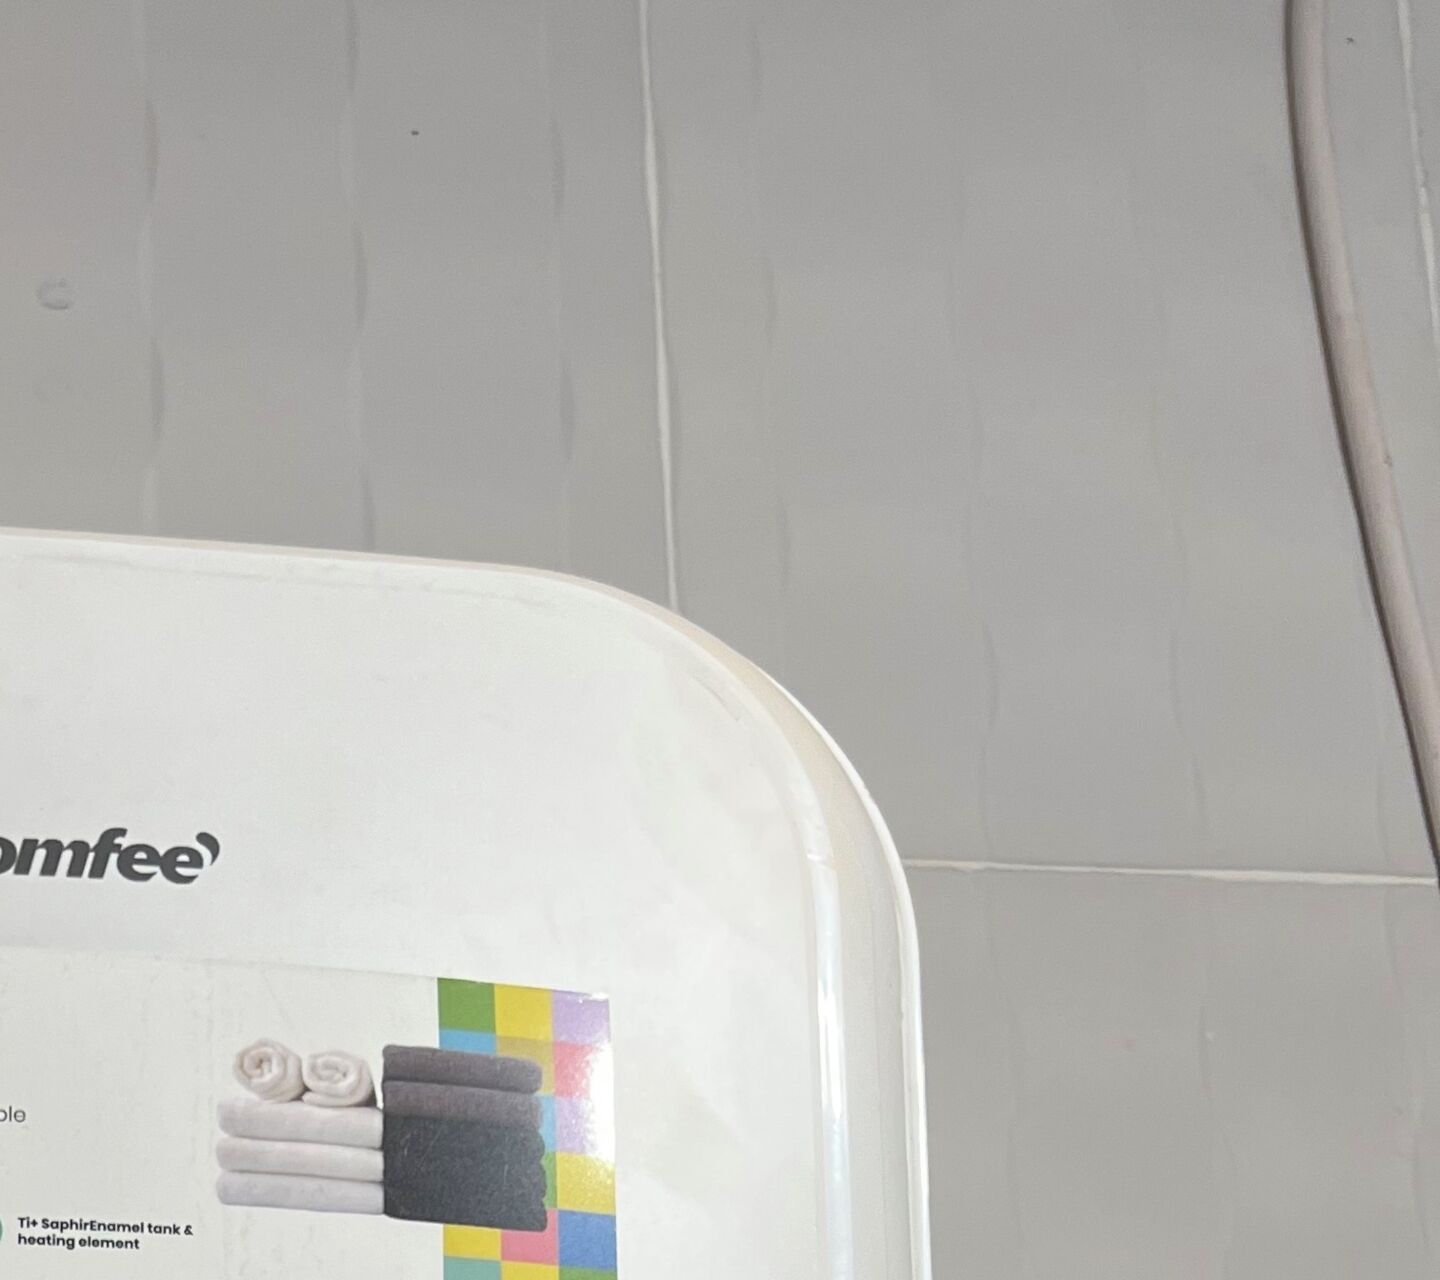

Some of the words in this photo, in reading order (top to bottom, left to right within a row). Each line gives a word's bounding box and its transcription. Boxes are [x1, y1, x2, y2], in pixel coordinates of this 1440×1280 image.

[17, 1216, 39, 1231] Ti+
[146, 1222, 181, 1236] tank
[183, 1224, 194, 1236] &
[16, 1232, 77, 1252] heating
[78, 1232, 141, 1251] element
